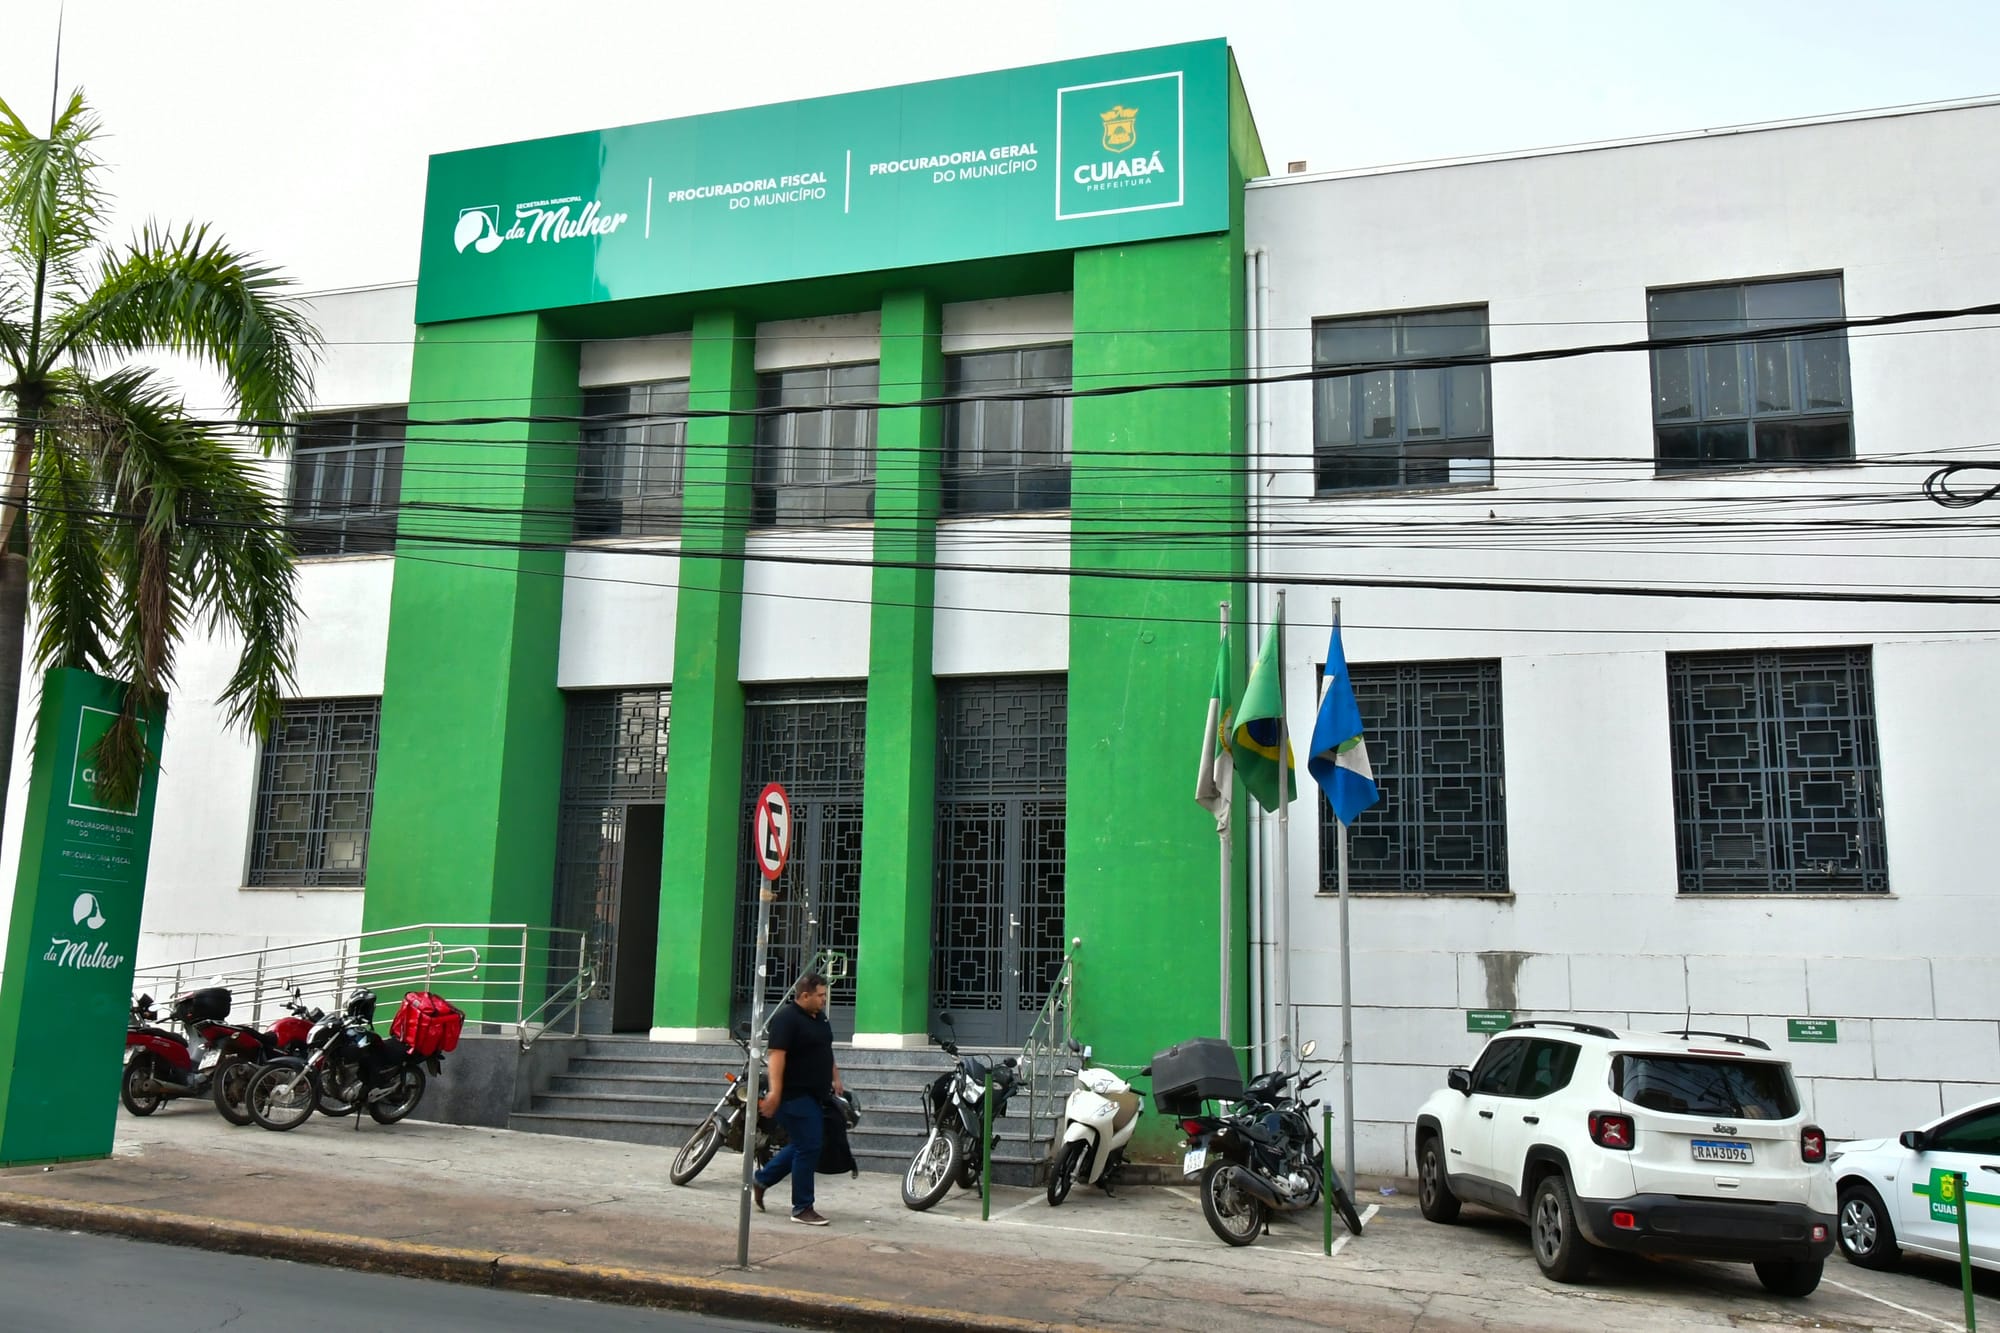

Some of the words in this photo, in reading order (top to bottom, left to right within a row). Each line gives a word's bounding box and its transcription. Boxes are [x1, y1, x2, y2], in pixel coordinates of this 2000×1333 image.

[869, 150, 987, 176] PROCURADORIA
[990, 143, 1038, 160] GERAL
[933, 170, 956, 184] DO
[960, 159, 1037, 181] MUNICÍPIO
[1074, 150, 1165, 184] CUIABÁ
[668, 178, 777, 203] PROCURADORIA
[781, 171, 827, 188] FISCAL
[1087, 177, 1152, 192] PREFEITURA
[516, 200, 549, 210] SECRETARIA
[550, 195, 582, 205] MUNICIPAL
[729, 197, 750, 210] DO
[754, 187, 826, 207] MUNICÍPIO
[505, 219, 526, 240] da
[515, 199, 628, 244] Mulher
[766, 801, 783, 861] E
[43, 945, 57, 961] da
[51, 937, 124, 970] Mulher
[1712, 1122, 1738, 1135] Jeep
[1697, 1146, 1747, 1161] RAW3D96
[1932, 1202, 1958, 1216] CUIAB
